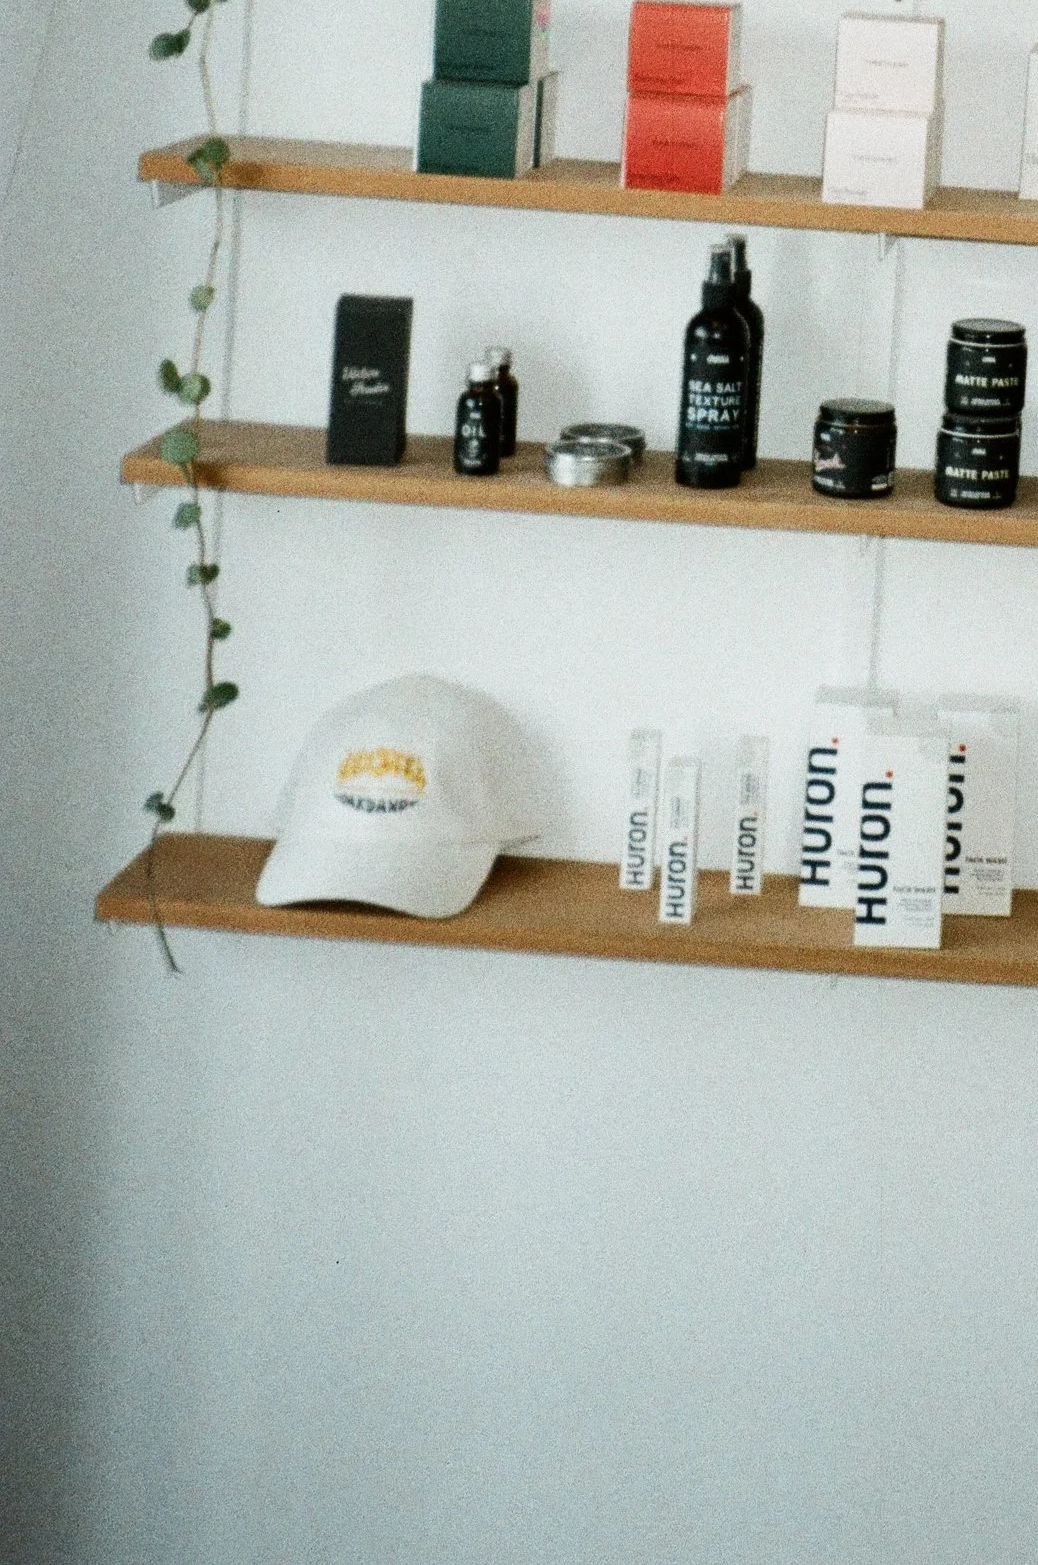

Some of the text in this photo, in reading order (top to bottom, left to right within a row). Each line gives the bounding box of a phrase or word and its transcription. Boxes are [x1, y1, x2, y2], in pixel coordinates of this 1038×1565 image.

[689, 379, 742, 394] SEA SALT
[955, 374, 1019, 388] MATTE PASTE
[689, 394, 741, 407] TEXTURE
[687, 406, 739, 423] SPRAY
[461, 422, 486, 438] OIL
[945, 466, 1010, 482] MATTE PASTE
[800, 736, 839, 887] Huron.
[856, 770, 893, 925] Huron.
